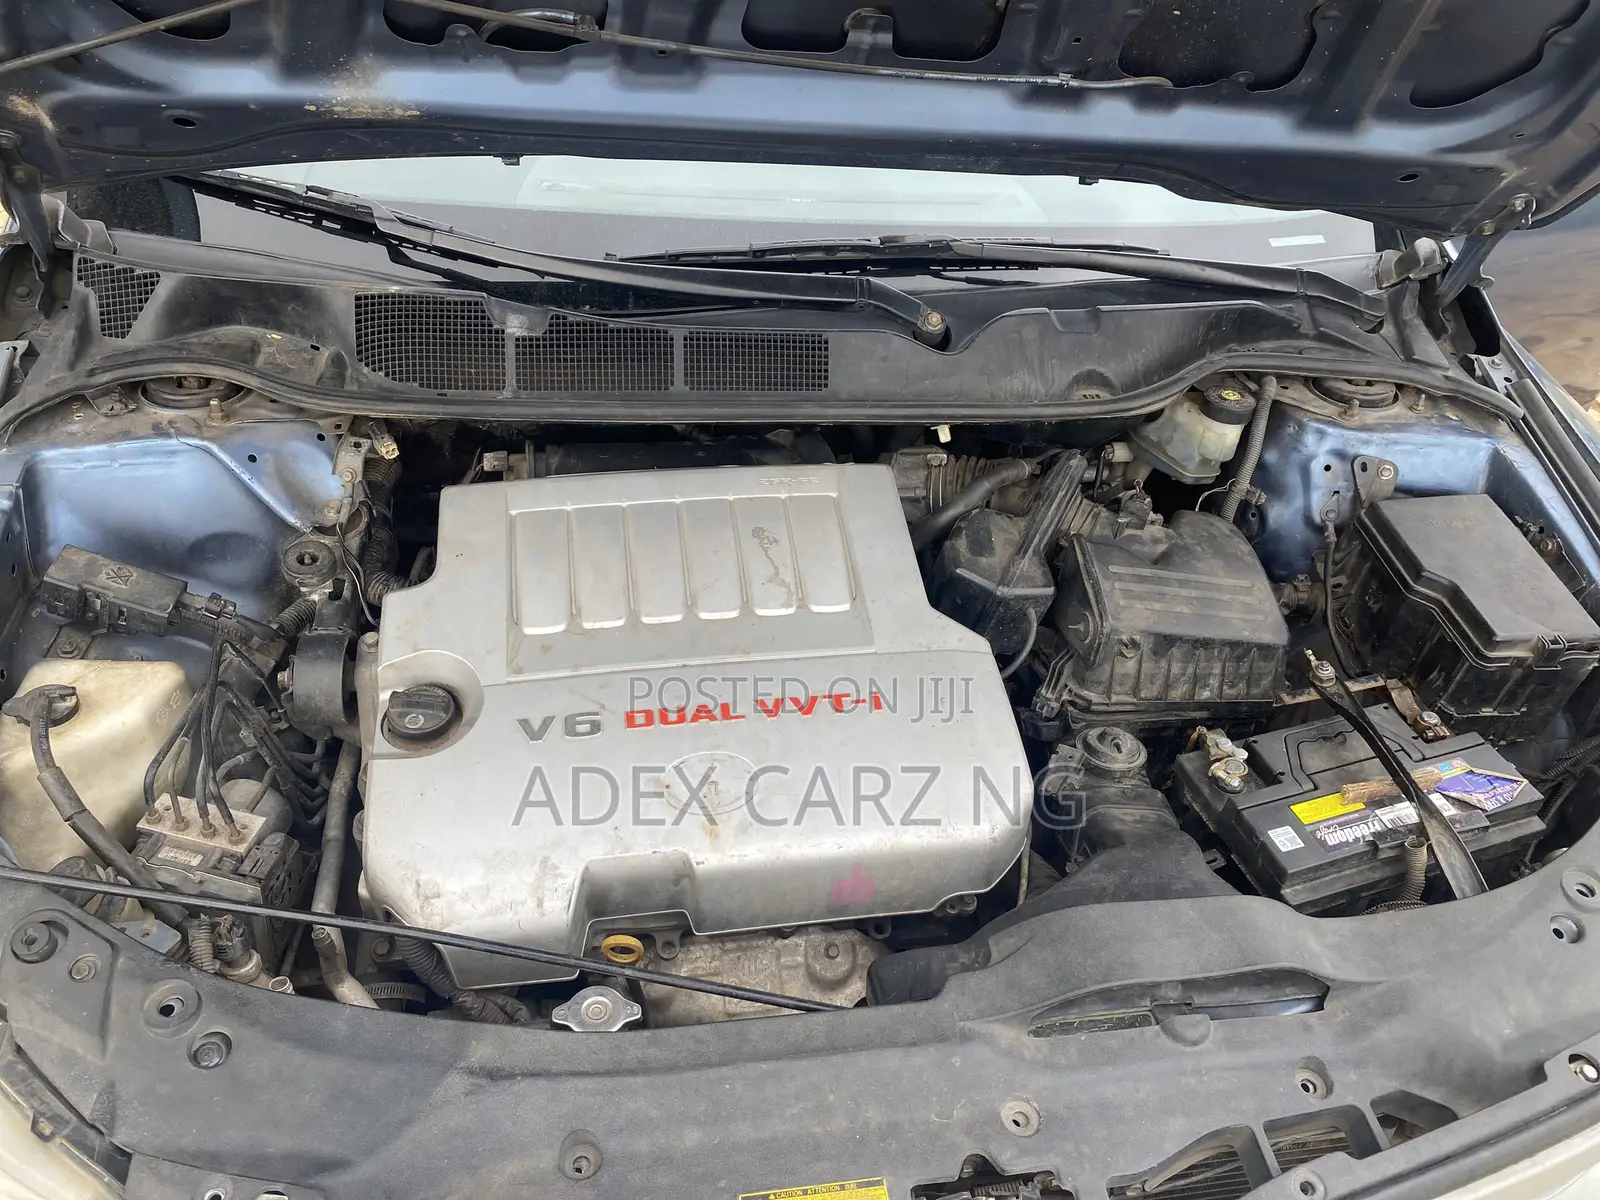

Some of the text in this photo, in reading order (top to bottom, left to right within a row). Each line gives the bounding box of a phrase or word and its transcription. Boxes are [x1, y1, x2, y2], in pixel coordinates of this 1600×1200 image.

[516, 711, 602, 743] V6
[625, 702, 746, 731] DUAL
[776, 1189, 803, 1199] CAUTION
[807, 1184, 841, 1196] ATTENTION
